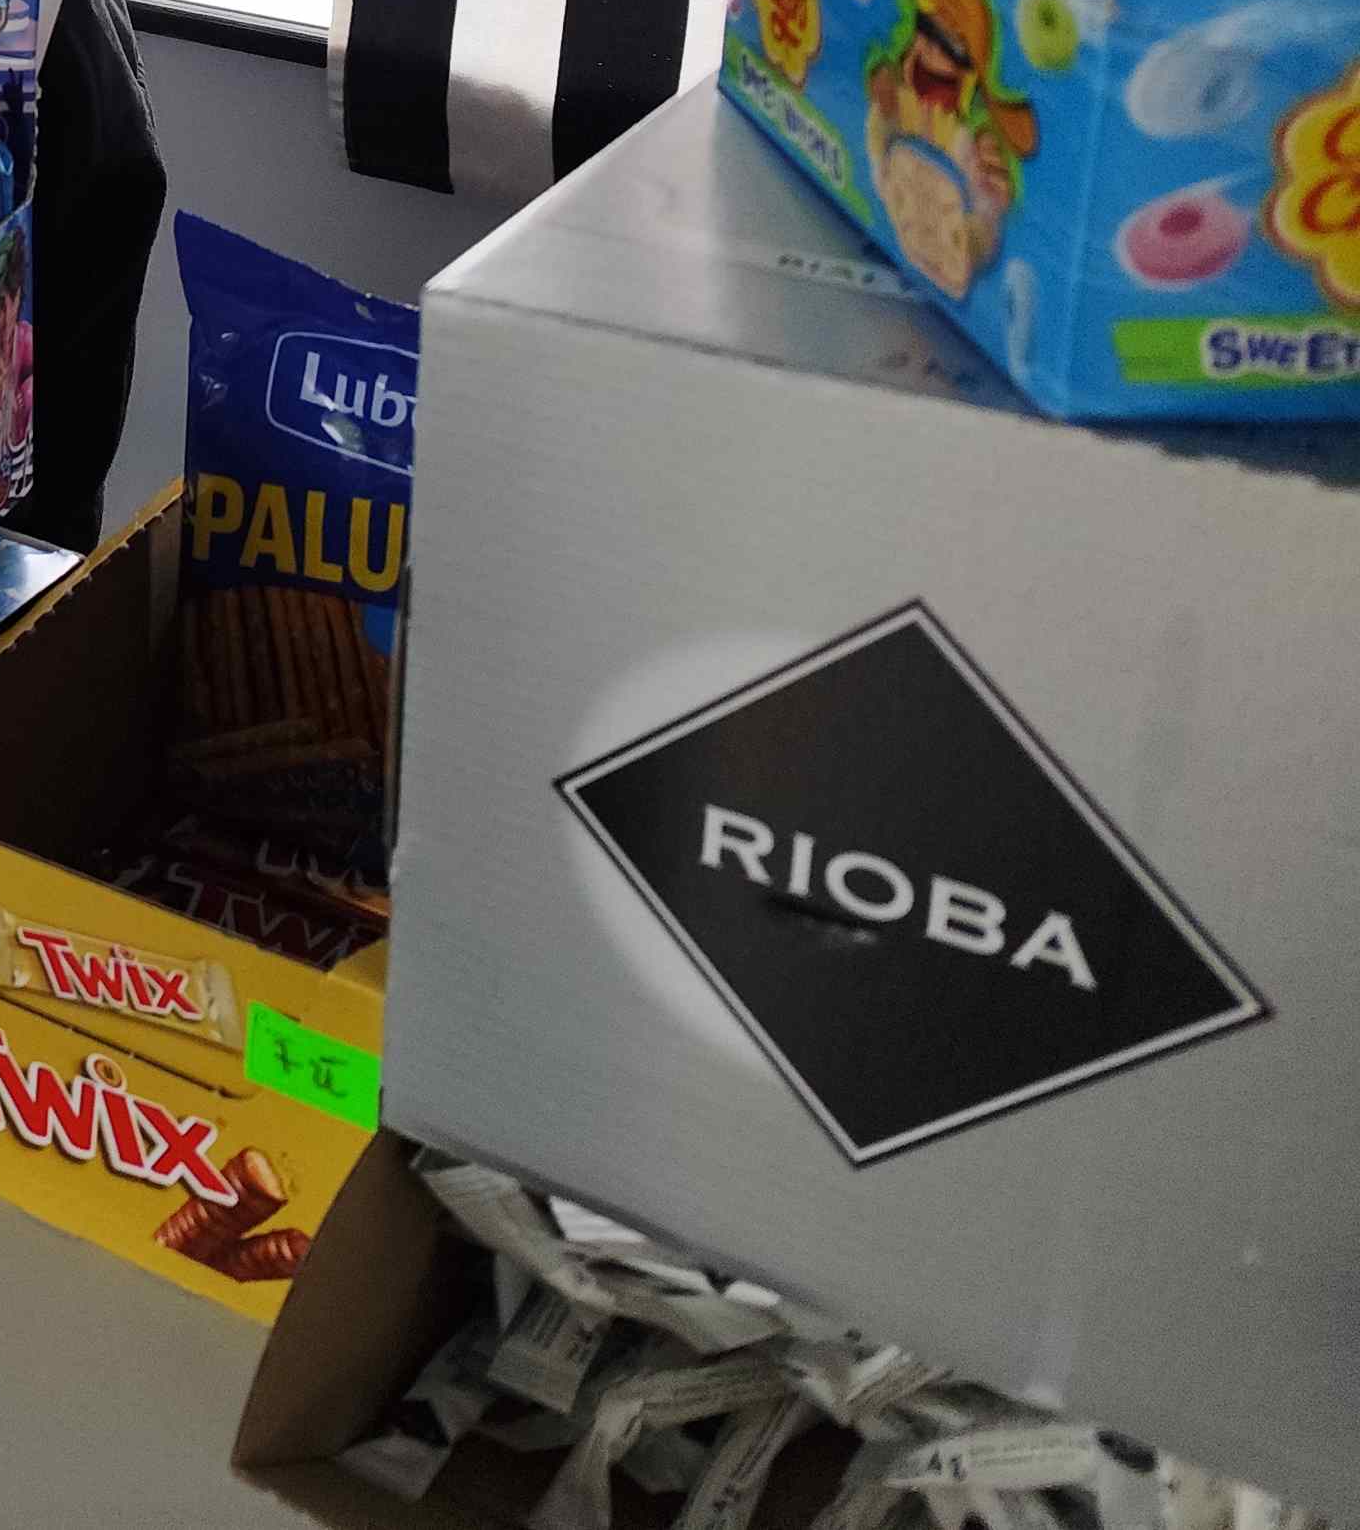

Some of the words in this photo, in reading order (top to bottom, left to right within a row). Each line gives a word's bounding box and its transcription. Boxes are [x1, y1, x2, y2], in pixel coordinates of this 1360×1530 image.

[298, 351, 417, 431] Lub
[697, 801, 1099, 991] RIOBA
[17, 926, 204, 1019] Twix
